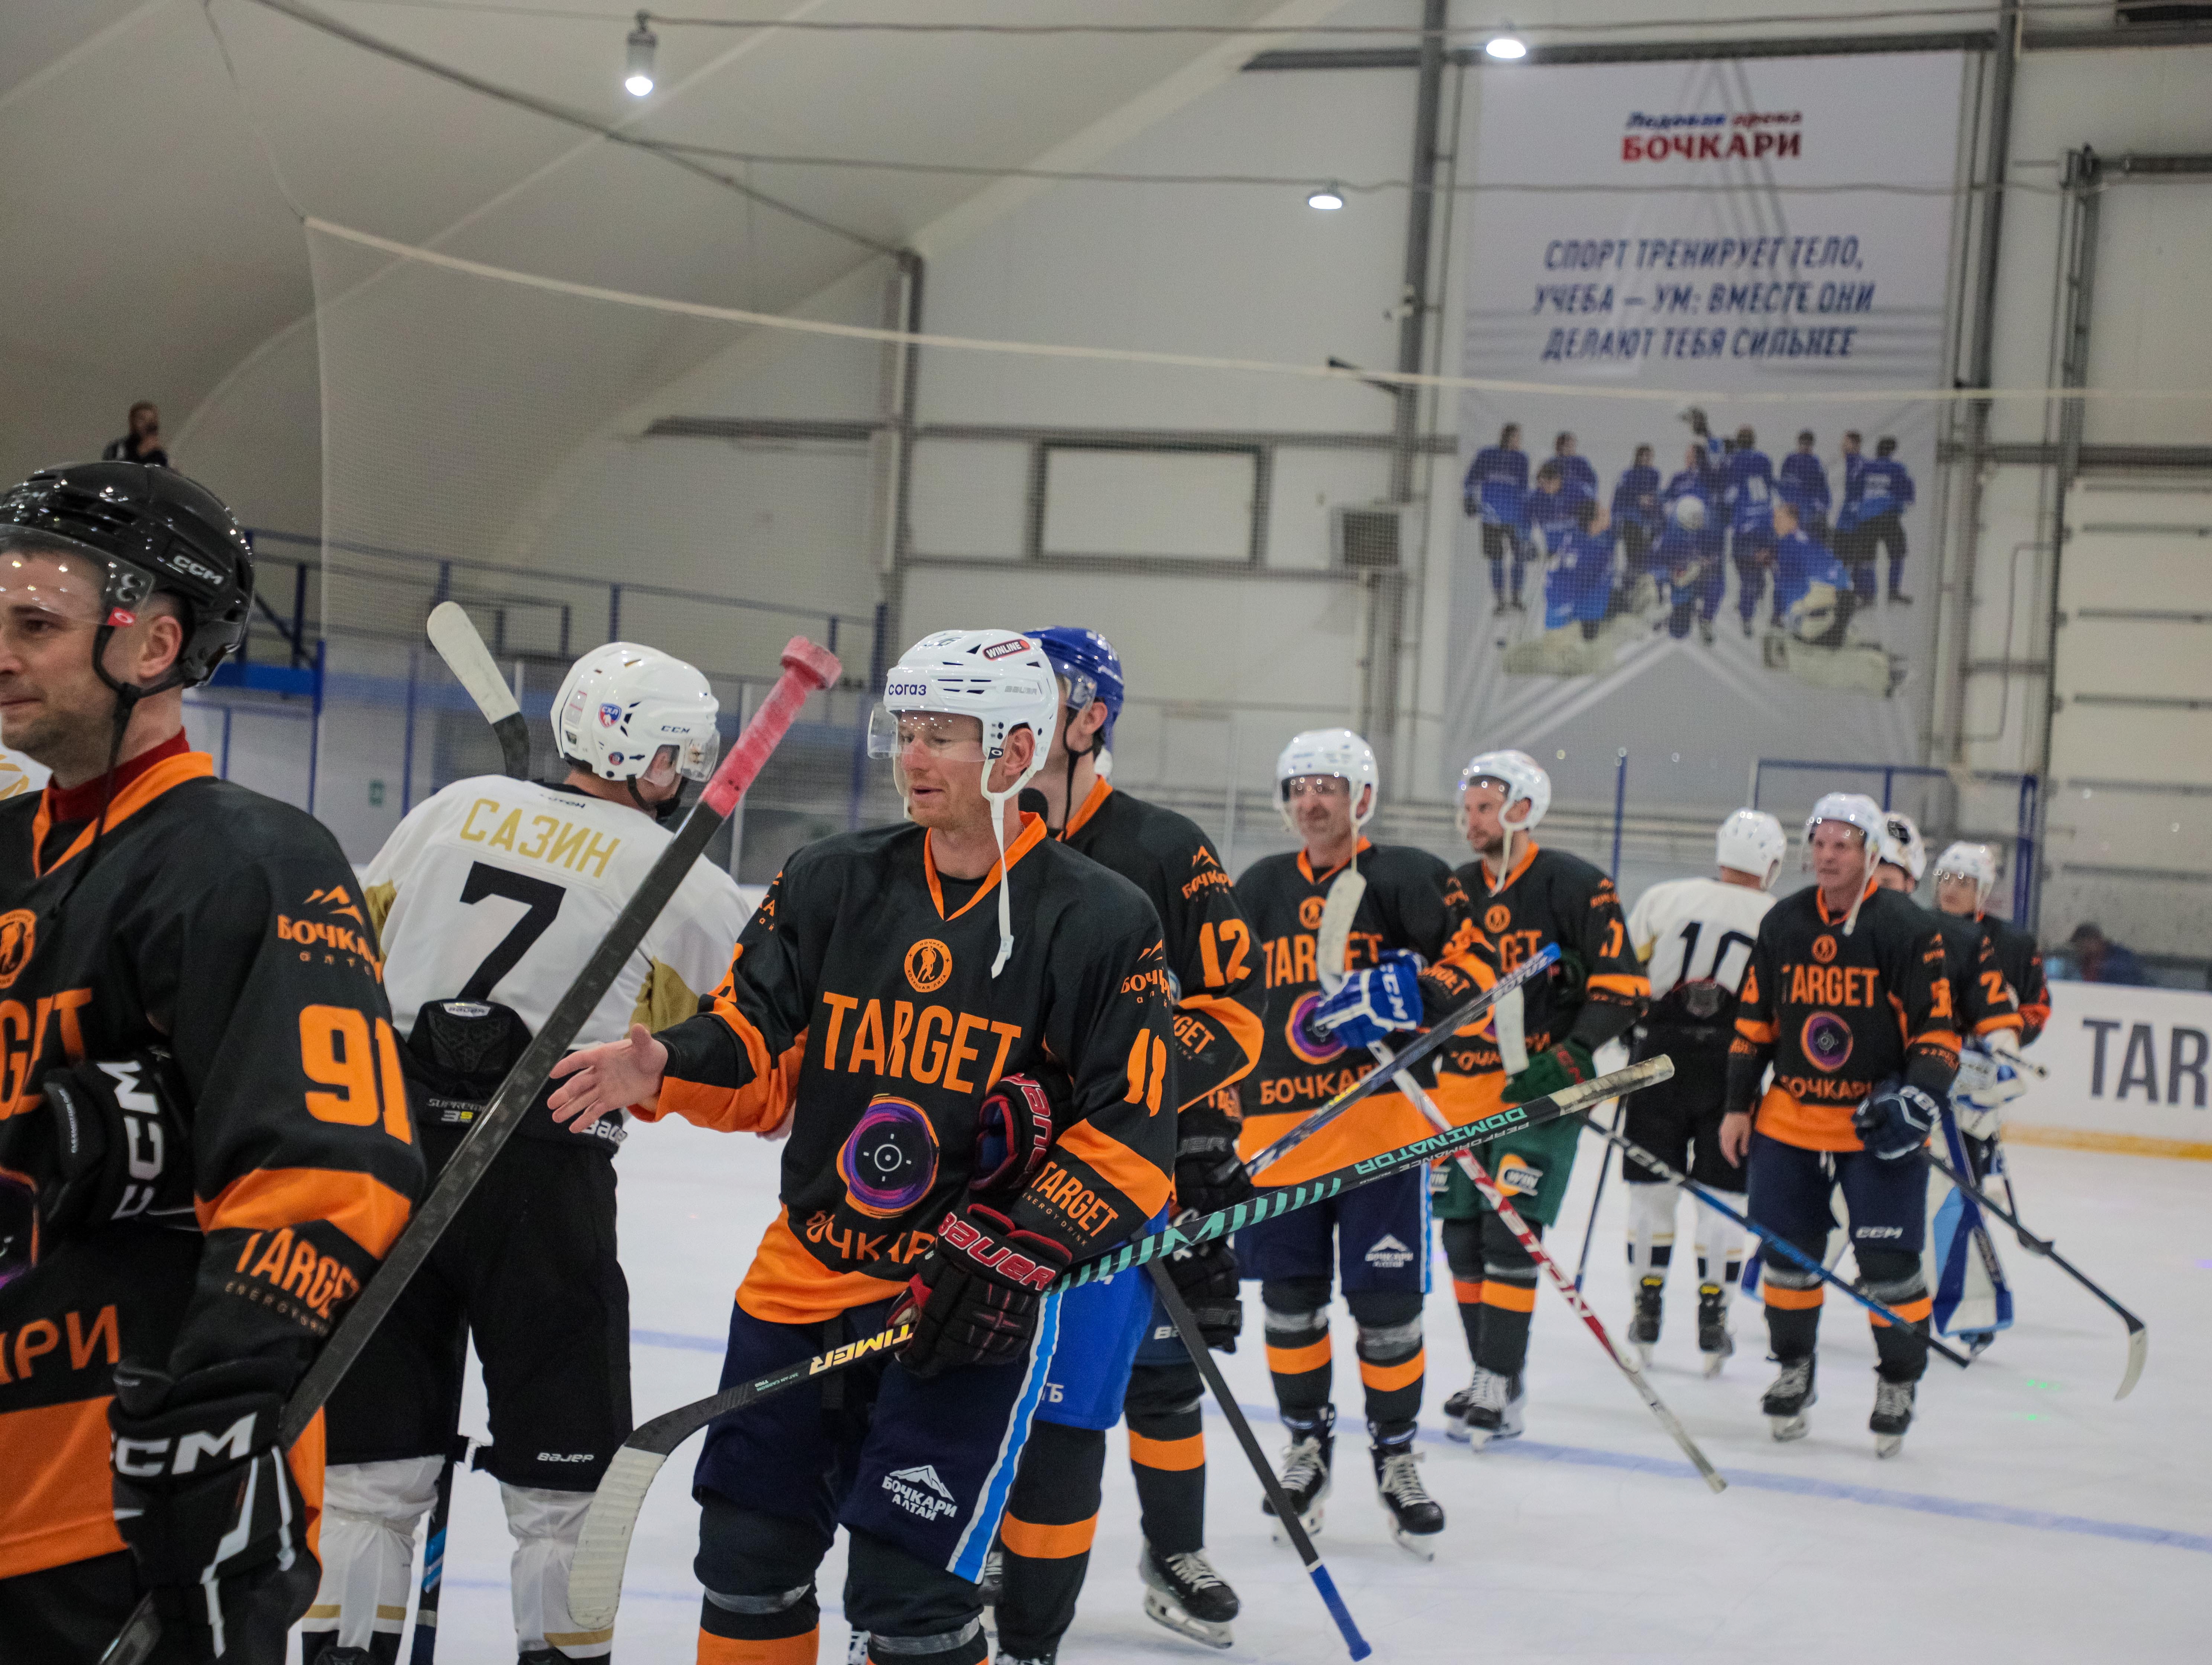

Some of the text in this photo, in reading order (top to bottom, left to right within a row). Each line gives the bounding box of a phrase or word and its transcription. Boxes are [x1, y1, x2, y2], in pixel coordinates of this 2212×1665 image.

[1623, 131, 1801, 162] БОЧКАРИ
[1544, 235, 1863, 271] СПОРТ ТРЕНИРУЕТ ТЕЛО,
[1531, 283, 1614, 315] УЧЕБА
[1708, 282, 1813, 314] ВМЕСТЕ
[1817, 282, 1875, 314] ОНИ
[1540, 326, 1857, 362] ДЕЛАЮТ ТЕБЯ СИЛЬНЕЕ
[173, 555, 224, 585] CCM
[987, 641, 1022, 658] WINLINE
[661, 725, 690, 734] CCM
[459, 798, 621, 878] САЗИН
[278, 915, 383, 984] БОЧКА
[459, 861, 567, 999] 7
[1199, 918, 1251, 987] 12
[1262, 931, 1383, 989] TARET
[822, 992, 1022, 1096] TARGET
[1173, 1014, 1216, 1055] GET
[299, 1004, 413, 1145] 91
[2082, 1018, 2209, 1109] TAR
[1355, 1106, 1527, 1174] DOMINATOR
[1399, 1121, 1529, 1171] PERFORMANCE
[1022, 1192, 1059, 1219] ENERGY
[1031, 1161, 1119, 1237] TARGET
[938, 1212, 1063, 1291] BAUER
[1856, 1227, 1904, 1239] CCM
[809, 1324, 913, 1375] TIMER
[110, 1412, 257, 1477] CM
[882, 1476, 958, 1518] БОЧКАРИ
